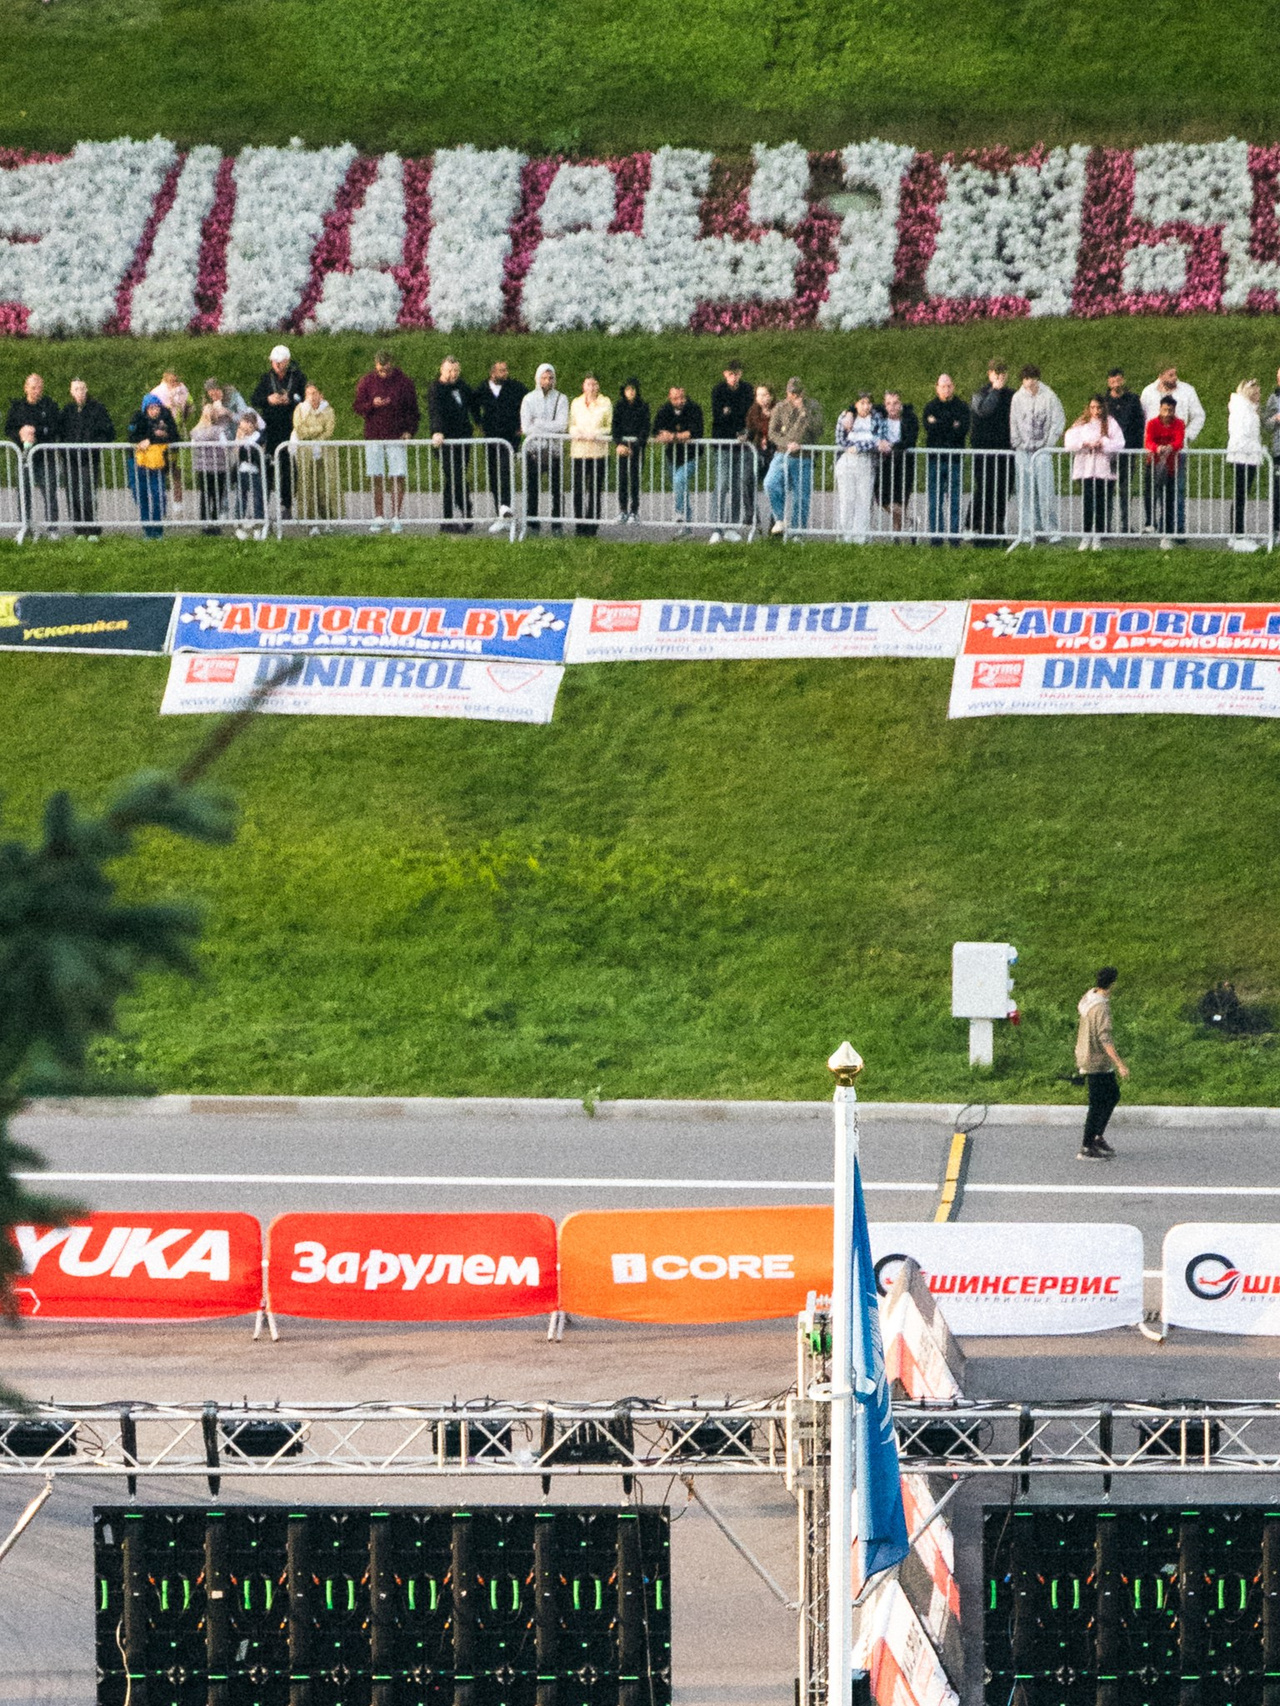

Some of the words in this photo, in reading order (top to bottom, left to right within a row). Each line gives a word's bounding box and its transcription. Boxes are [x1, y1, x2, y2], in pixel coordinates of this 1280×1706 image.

[220, 603, 531, 641] AUTORUL.BY
[658, 604, 878, 633] DINITROL
[259, 633, 309, 647] ПРО
[1056, 637, 1108, 651] ПРО
[1041, 656, 1265, 691] DINITROL
[14, 1224, 231, 1282] YUKA
[929, 1275, 1122, 1294] ШИНСЕРВИС
